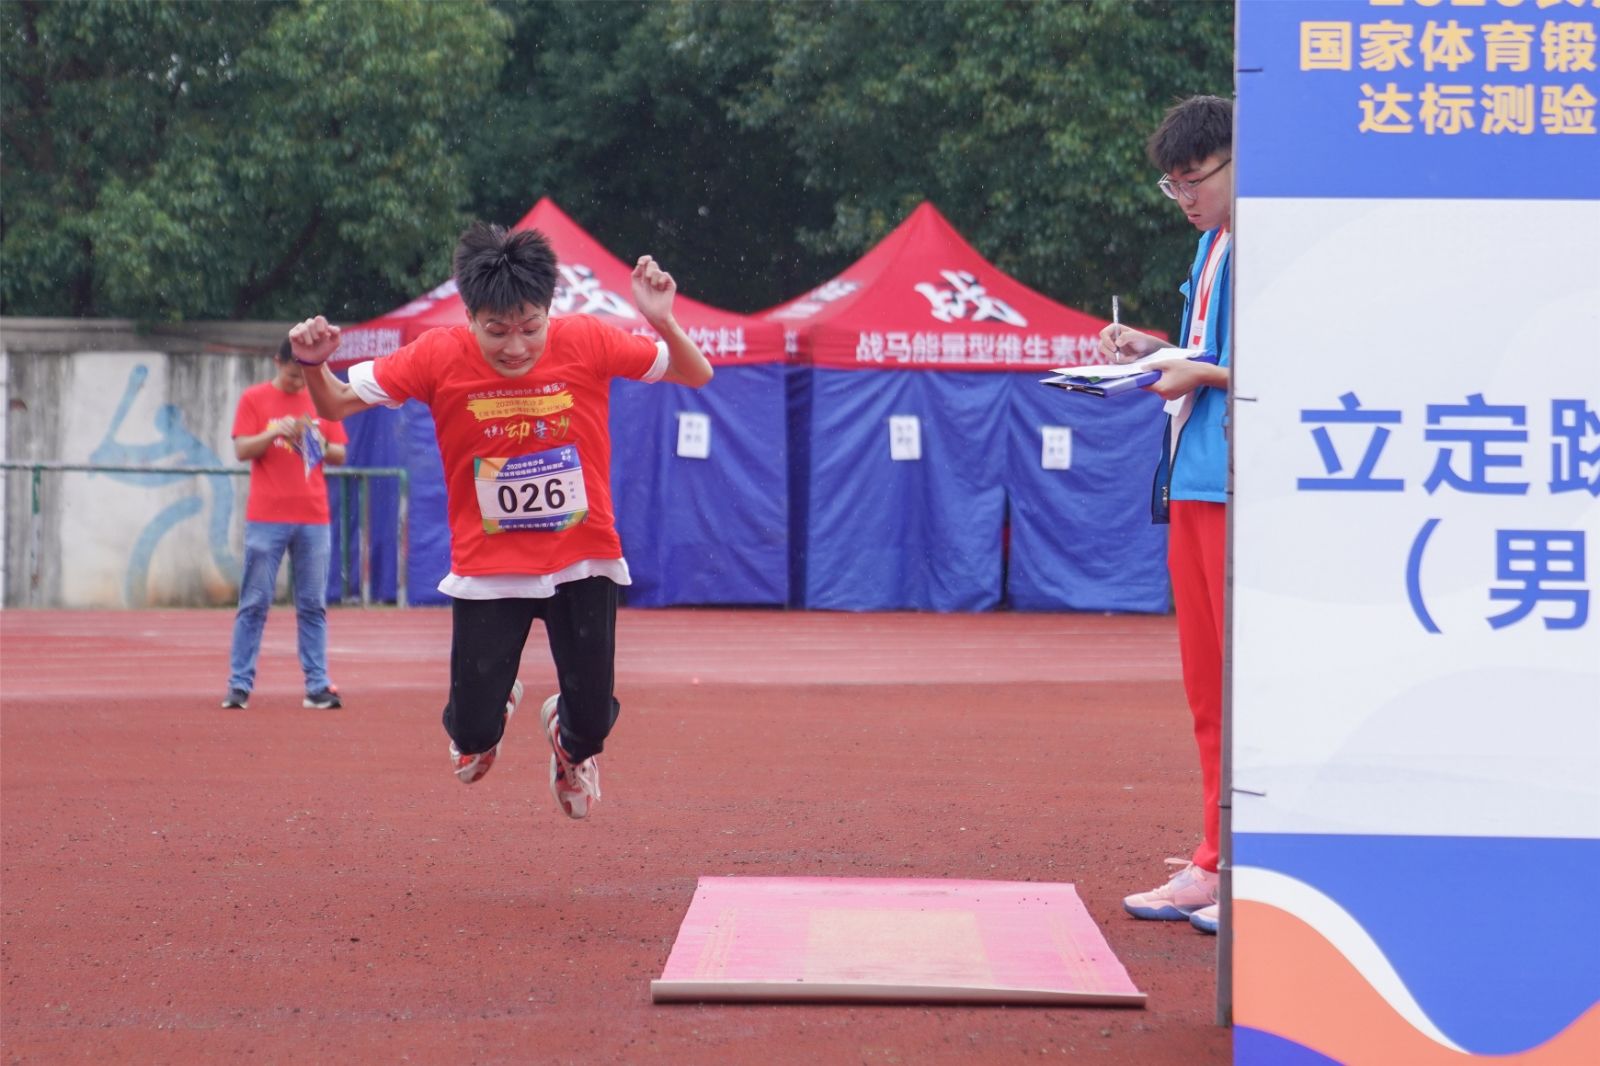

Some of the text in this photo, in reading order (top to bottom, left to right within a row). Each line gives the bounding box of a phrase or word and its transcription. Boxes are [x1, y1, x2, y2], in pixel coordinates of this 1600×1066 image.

[1299, 20, 1598, 72] 国家体育锻
[1358, 82, 1598, 135] 达标测验
[855, 332, 1108, 365] 战马能量型维生素饮
[498, 478, 566, 513] 026
